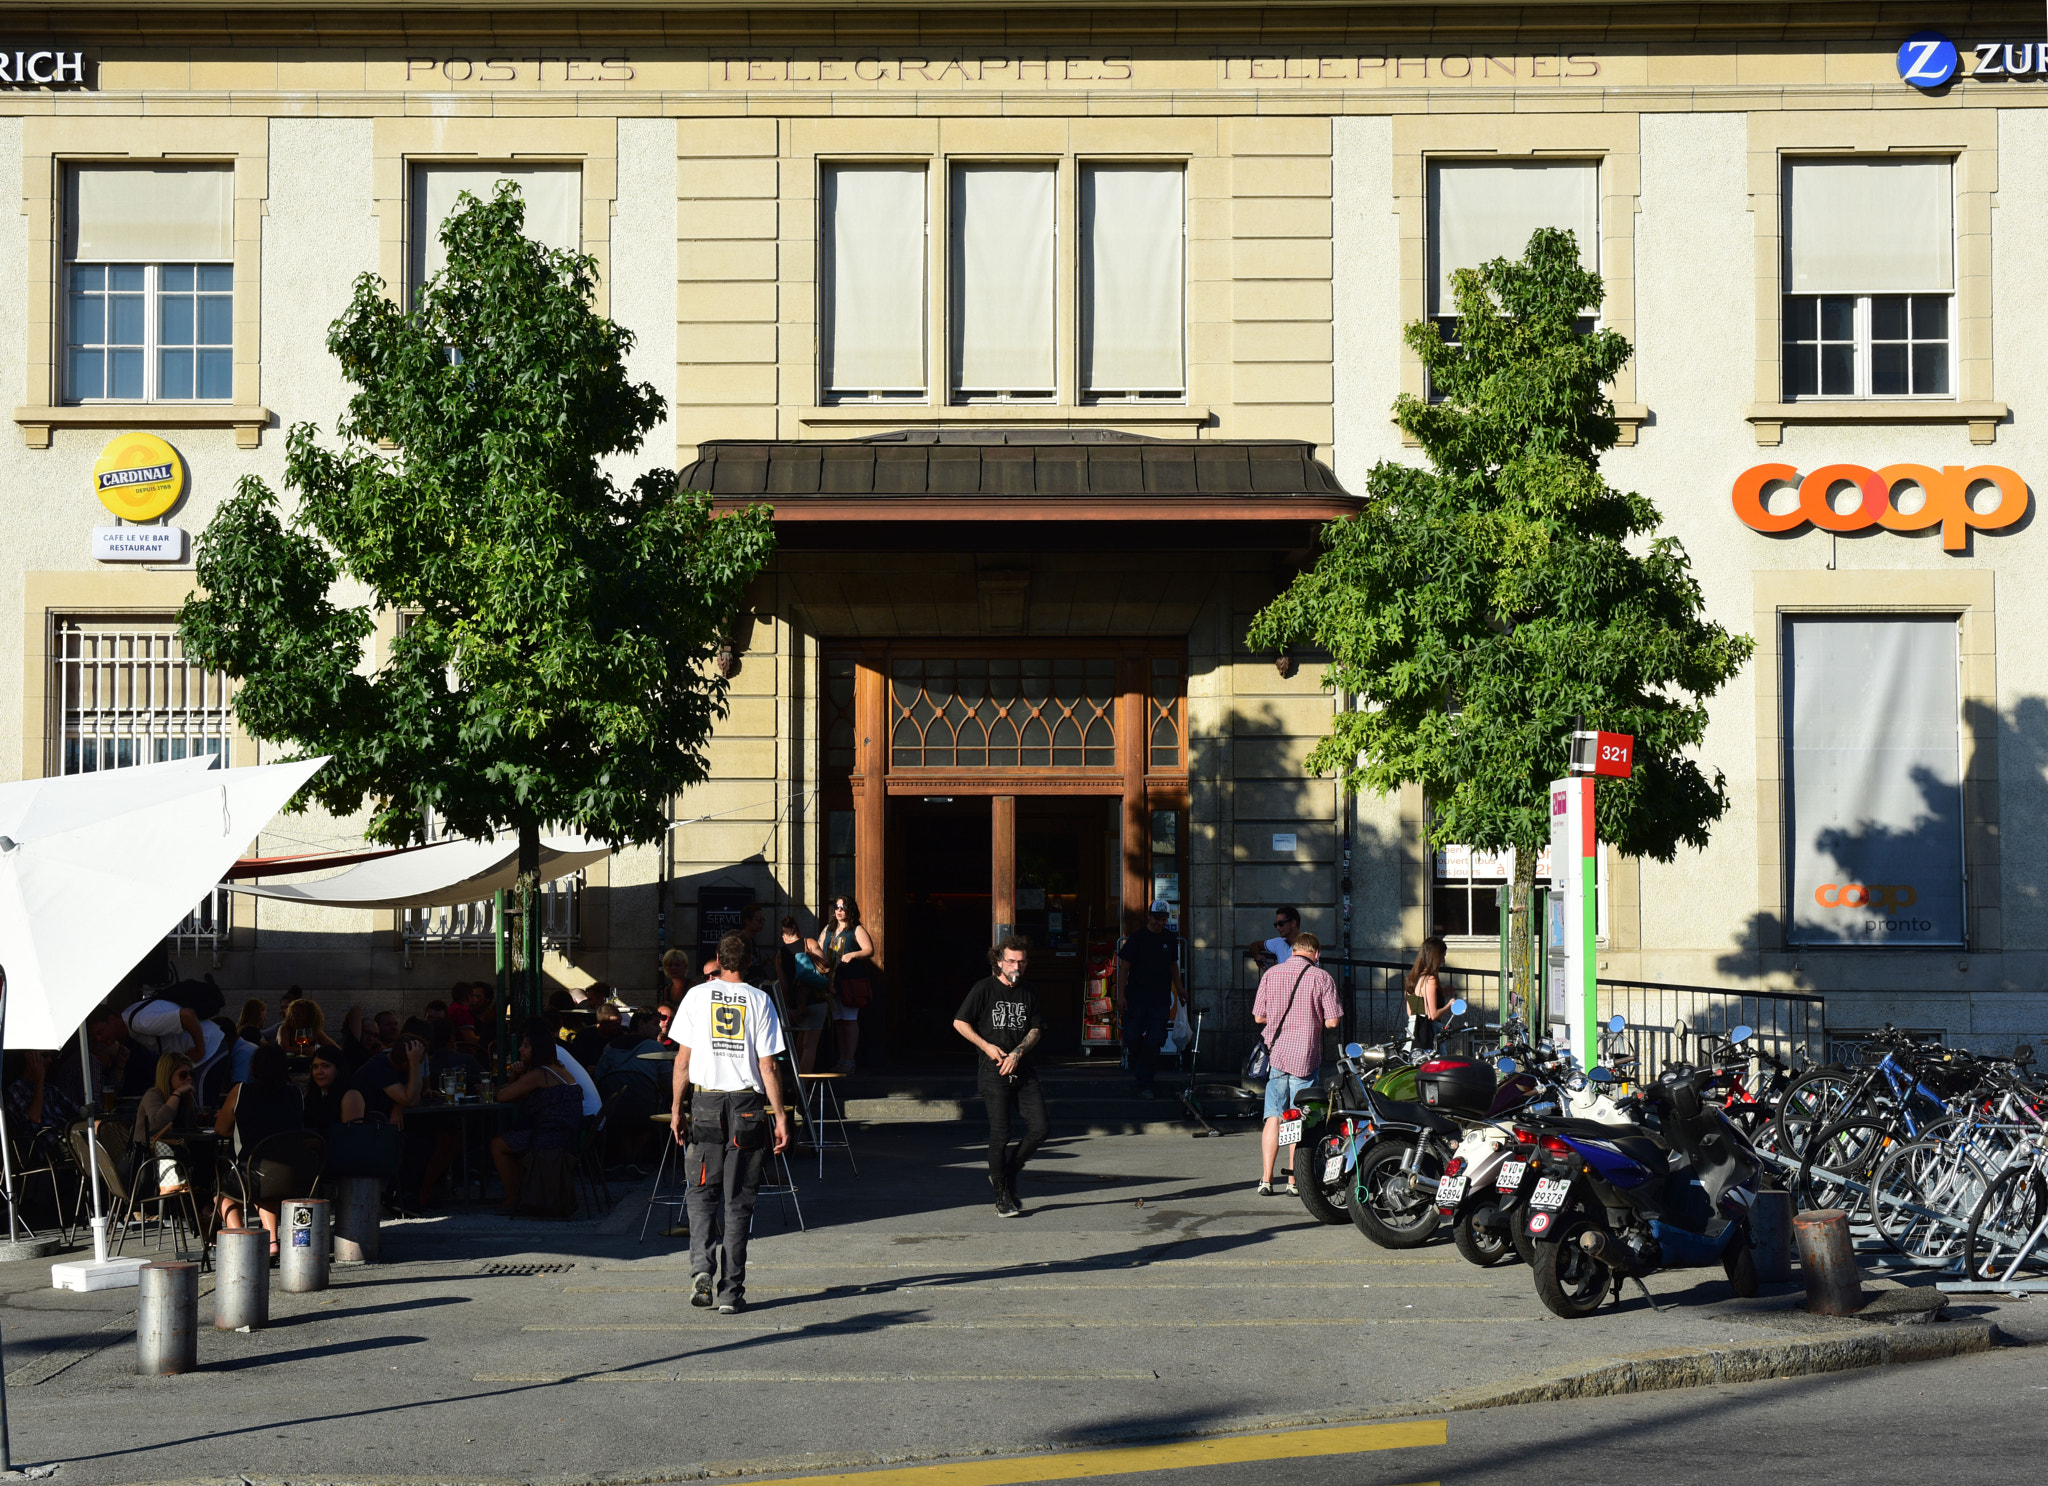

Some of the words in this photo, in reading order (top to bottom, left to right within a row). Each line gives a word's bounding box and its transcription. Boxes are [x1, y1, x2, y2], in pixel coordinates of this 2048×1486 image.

[405, 56, 637, 81] POSTES
[710, 55, 1133, 81] TELEGRAPHES
[1208, 52, 1601, 79] TELEPHONES
[102, 466, 171, 486] CARDINAL
[135, 486, 157, 494] DEPUIS
[1731, 463, 2028, 550] coop
[109, 544, 162, 552] RESTAURANT
[1602, 745, 1627, 762] 321
[1438, 857, 1469, 865] ouvert
[1475, 857, 1496, 865] tous
[1438, 868, 1452, 876] les
[1453, 867, 1481, 877] jours
[1814, 883, 1918, 915] coop
[1865, 917, 1932, 933] pronto
[711, 990, 747, 1003] Bois
[715, 1006, 742, 1036] 9
[1286, 1122, 1295, 1132] VD
[1279, 1132, 1300, 1145] 33331
[1509, 1163, 1518, 1174] VD
[1447, 1177, 1458, 1188] VD
[1497, 1175, 1520, 1187] 29342
[1547, 1180, 1559, 1191] VD
[1437, 1188, 1461, 1200] 45894
[1533, 1191, 1563, 1205] 99378
[1535, 1217, 1545, 1227] 70
